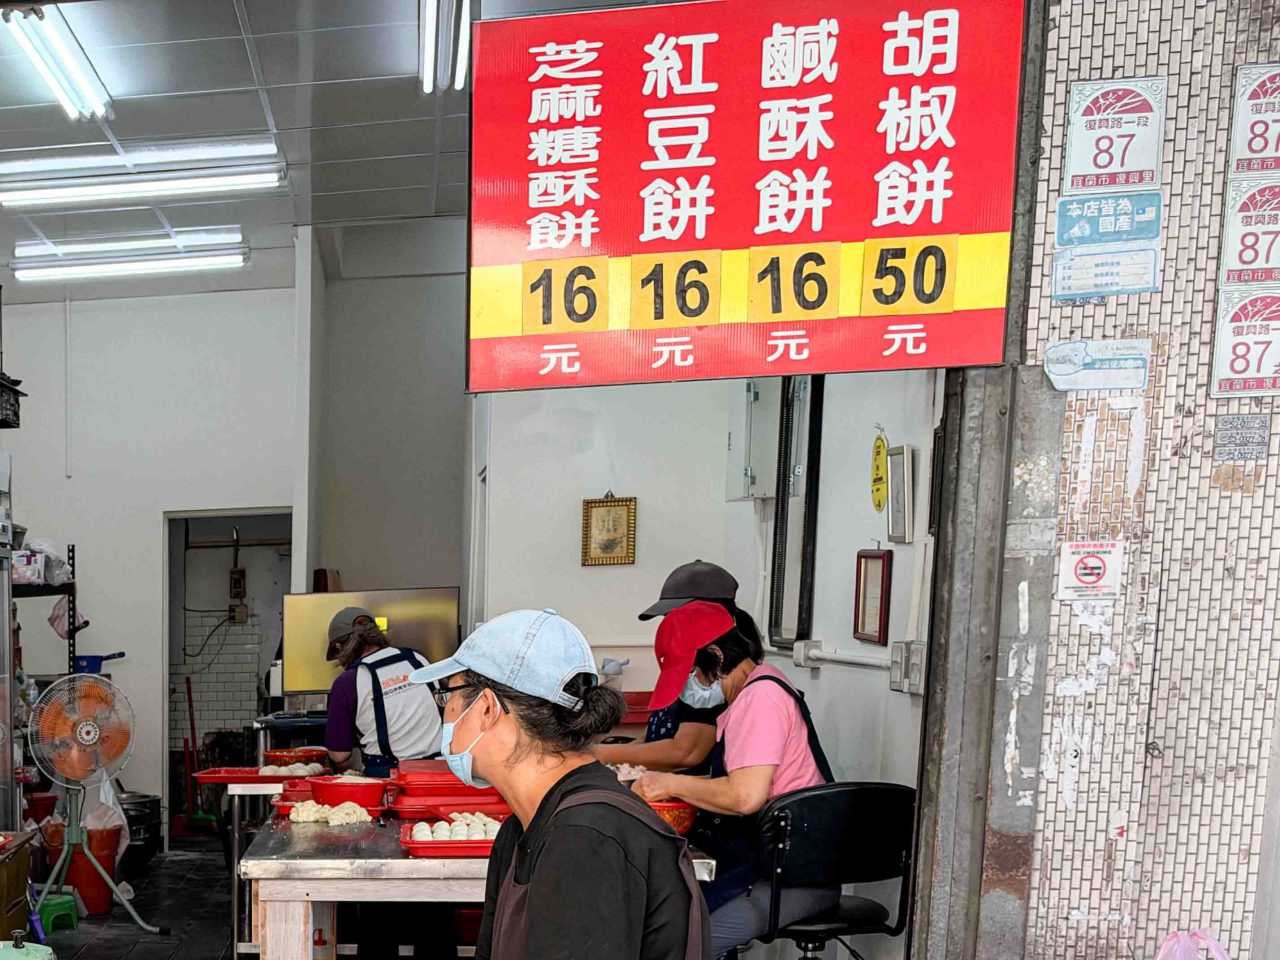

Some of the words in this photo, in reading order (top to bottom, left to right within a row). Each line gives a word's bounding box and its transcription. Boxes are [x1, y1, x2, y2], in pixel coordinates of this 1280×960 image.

[754, 18, 838, 235] 鹹酥餅
[872, 9, 959, 226] 胡椒餅
[1084, 115, 1150, 130] 復興路一段
[527, 40, 603, 250] 芝麻糖酥餅
[639, 32, 719, 242] 紅豆餅
[1092, 133, 1136, 169] 87
[1073, 174, 1109, 188] 宜蘭市
[1238, 231, 1280, 266] 87
[640, 258, 710, 320] 16
[757, 252, 828, 314] 16
[872, 245, 947, 305] 50
[529, 264, 597, 326] 16
[652, 337, 694, 368] 元
[767, 330, 810, 360] 元
[882, 324, 927, 357] 元
[1229, 340, 1273, 375] 87
[540, 344, 580, 375] 元
